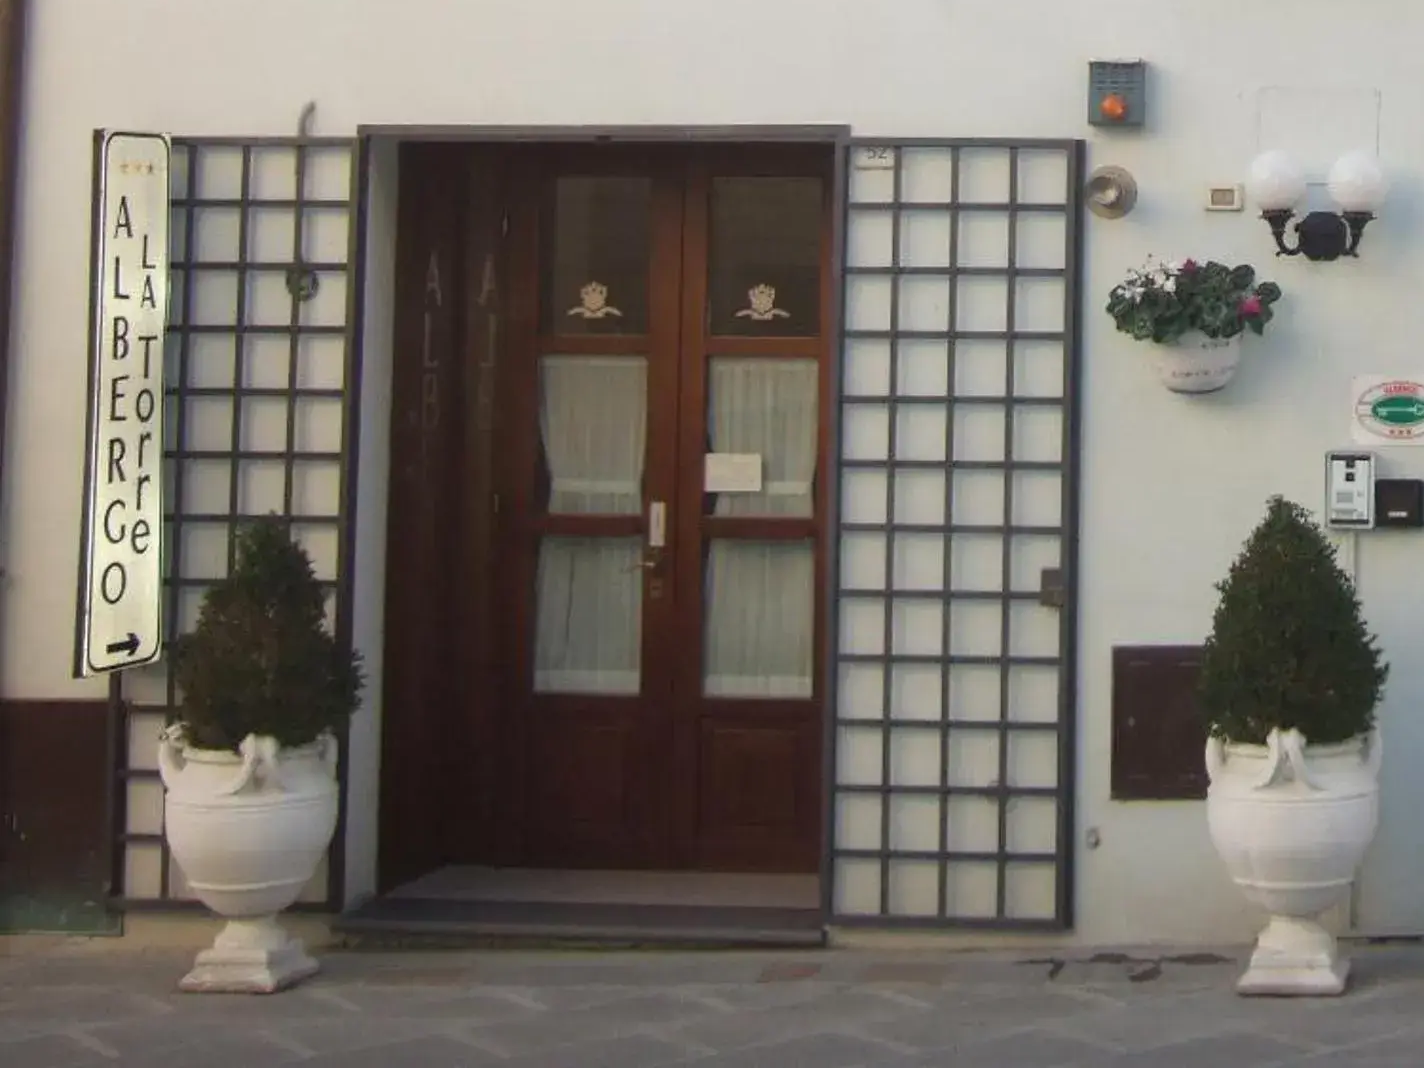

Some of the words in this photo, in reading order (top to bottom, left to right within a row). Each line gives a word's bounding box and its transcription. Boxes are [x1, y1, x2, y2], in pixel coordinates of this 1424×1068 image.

[141, 234, 157, 309] LA
[101, 195, 134, 605] ALBERGO
[130, 335, 159, 555] Torre
